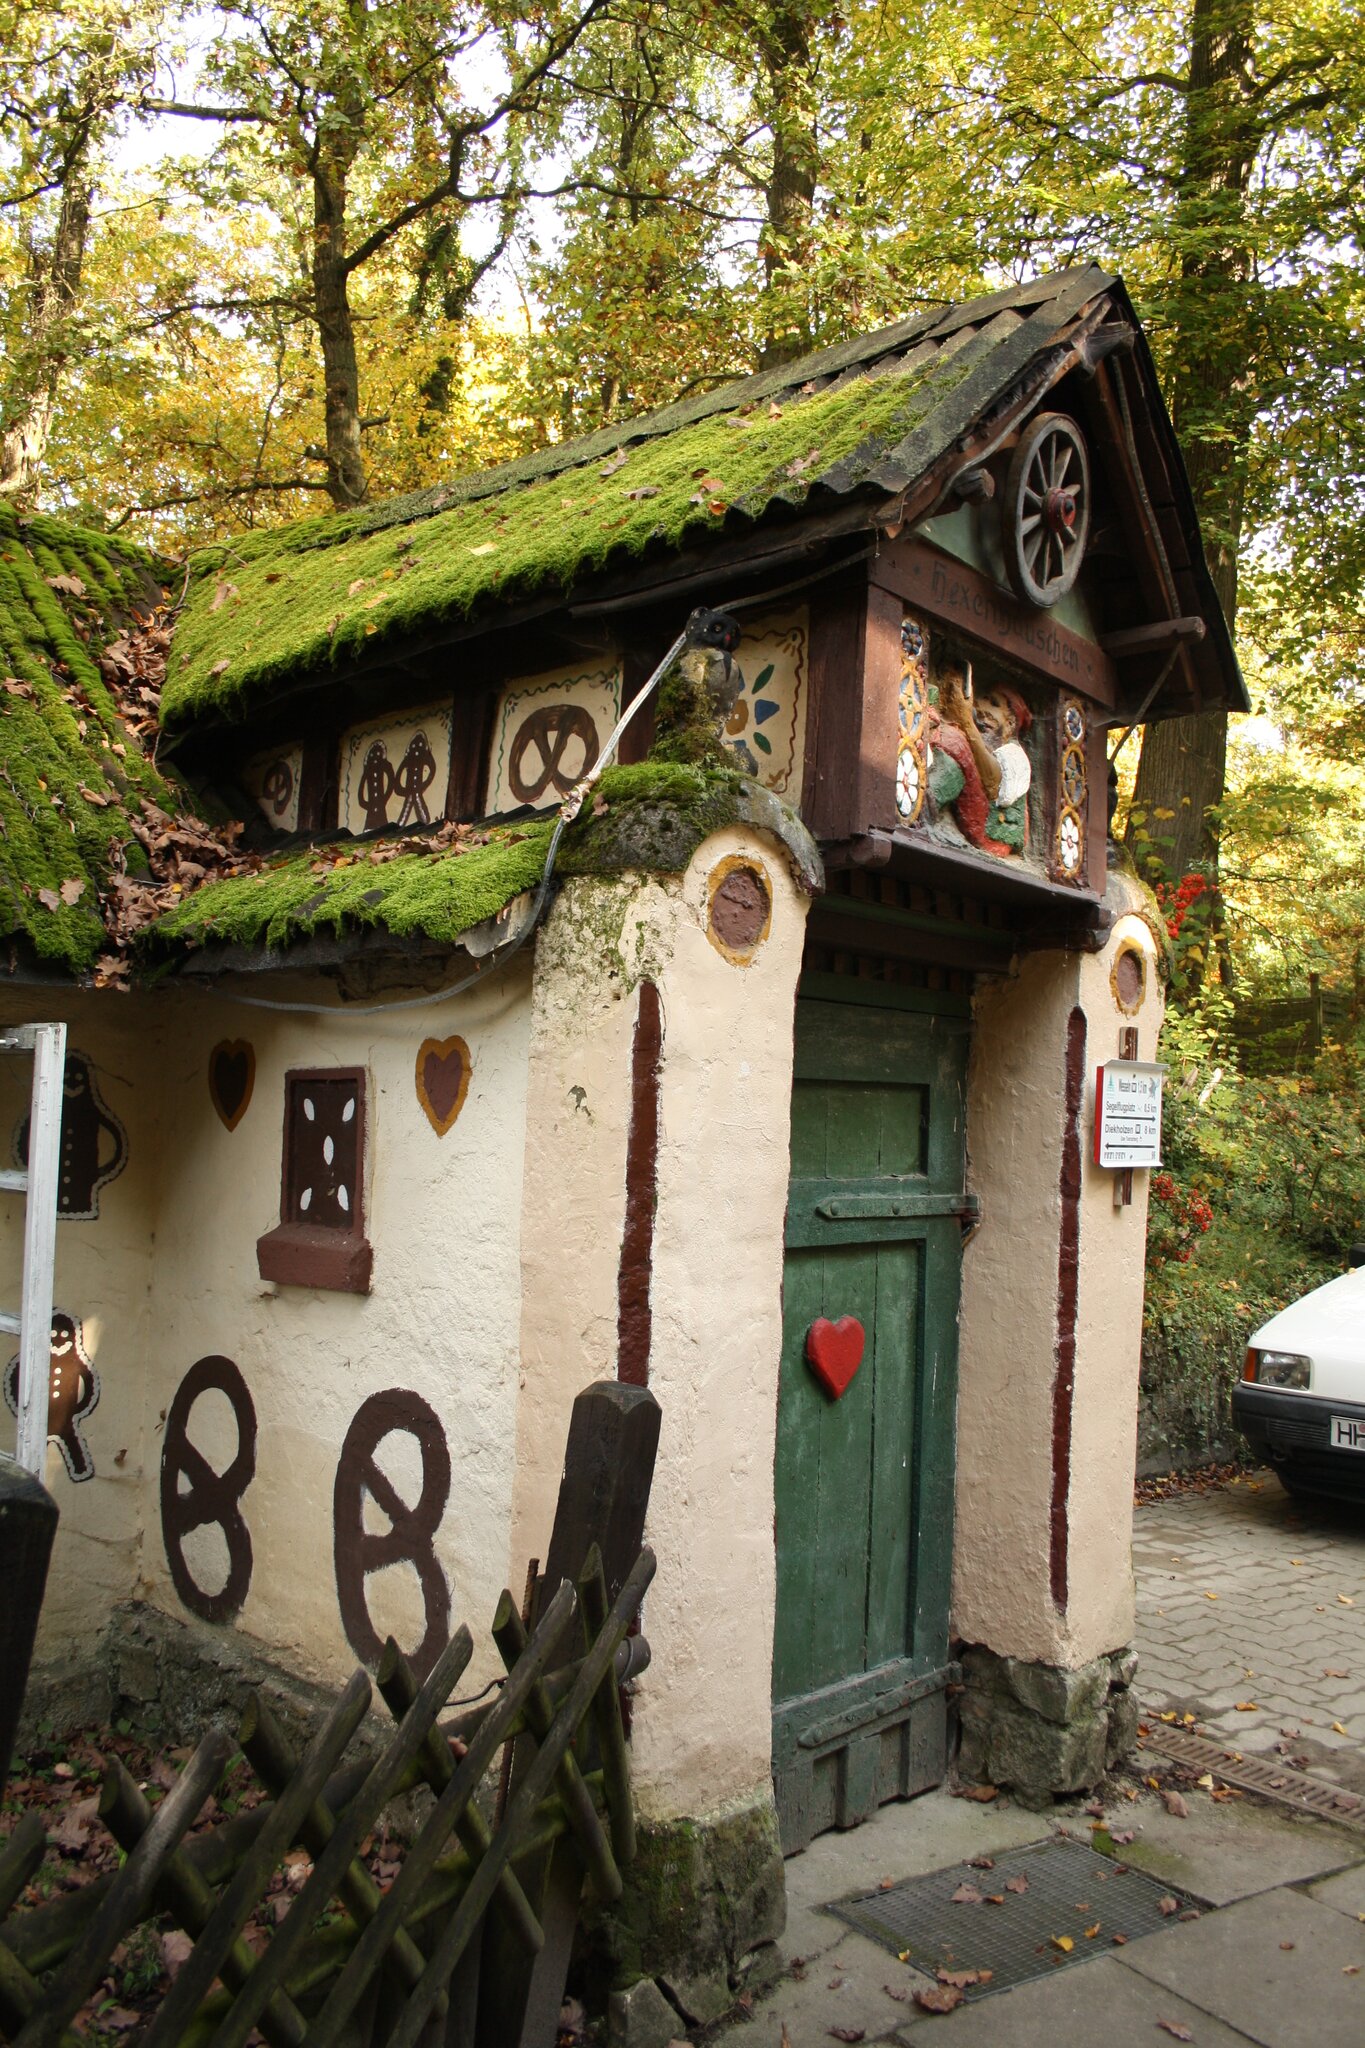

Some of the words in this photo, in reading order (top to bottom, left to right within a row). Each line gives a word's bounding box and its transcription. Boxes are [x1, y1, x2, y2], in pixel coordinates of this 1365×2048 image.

[1106, 1101, 1136, 1113] Segelflugplatz
[1105, 1124, 1134, 1135] Diekholzen
[1148, 1126, 1156, 1135] km
